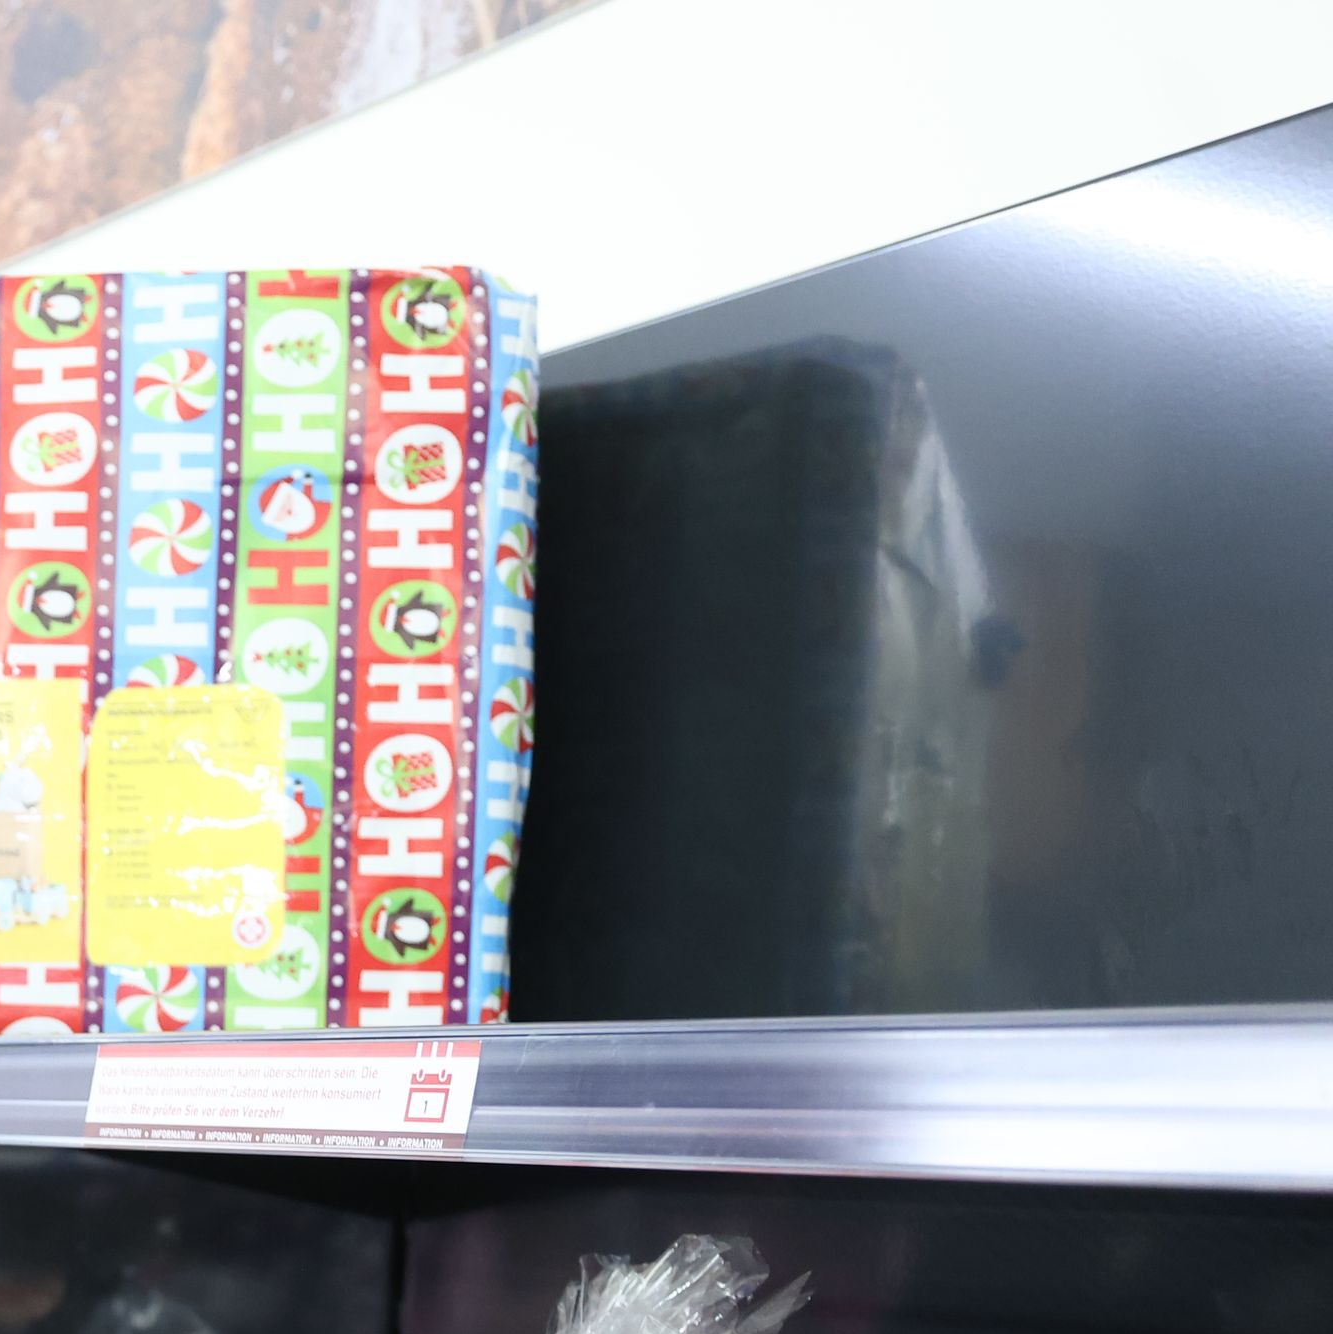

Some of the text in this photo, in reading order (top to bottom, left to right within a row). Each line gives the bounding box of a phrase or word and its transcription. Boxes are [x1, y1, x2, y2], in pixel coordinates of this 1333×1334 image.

[237, 1066, 261, 1079] kann
[263, 1065, 331, 1080] überschritten
[361, 1066, 379, 1079] Die
[230, 1086, 269, 1099] Zustand
[272, 1086, 318, 1099] weiterhin
[321, 1087, 381, 1101] konsumiert
[129, 1103, 151, 1115] Bitte
[152, 1103, 182, 1117] prüfen
[185, 1105, 200, 1116] Sie
[201, 1107, 216, 1117] vor
[219, 1106, 240, 1118] dem
[242, 1106, 285, 1119] Verzehr!
[99, 1128, 444, 1150] INFORMATION INFORMATION INFORMATION INFORMATION INFORMATION INFORMATION
